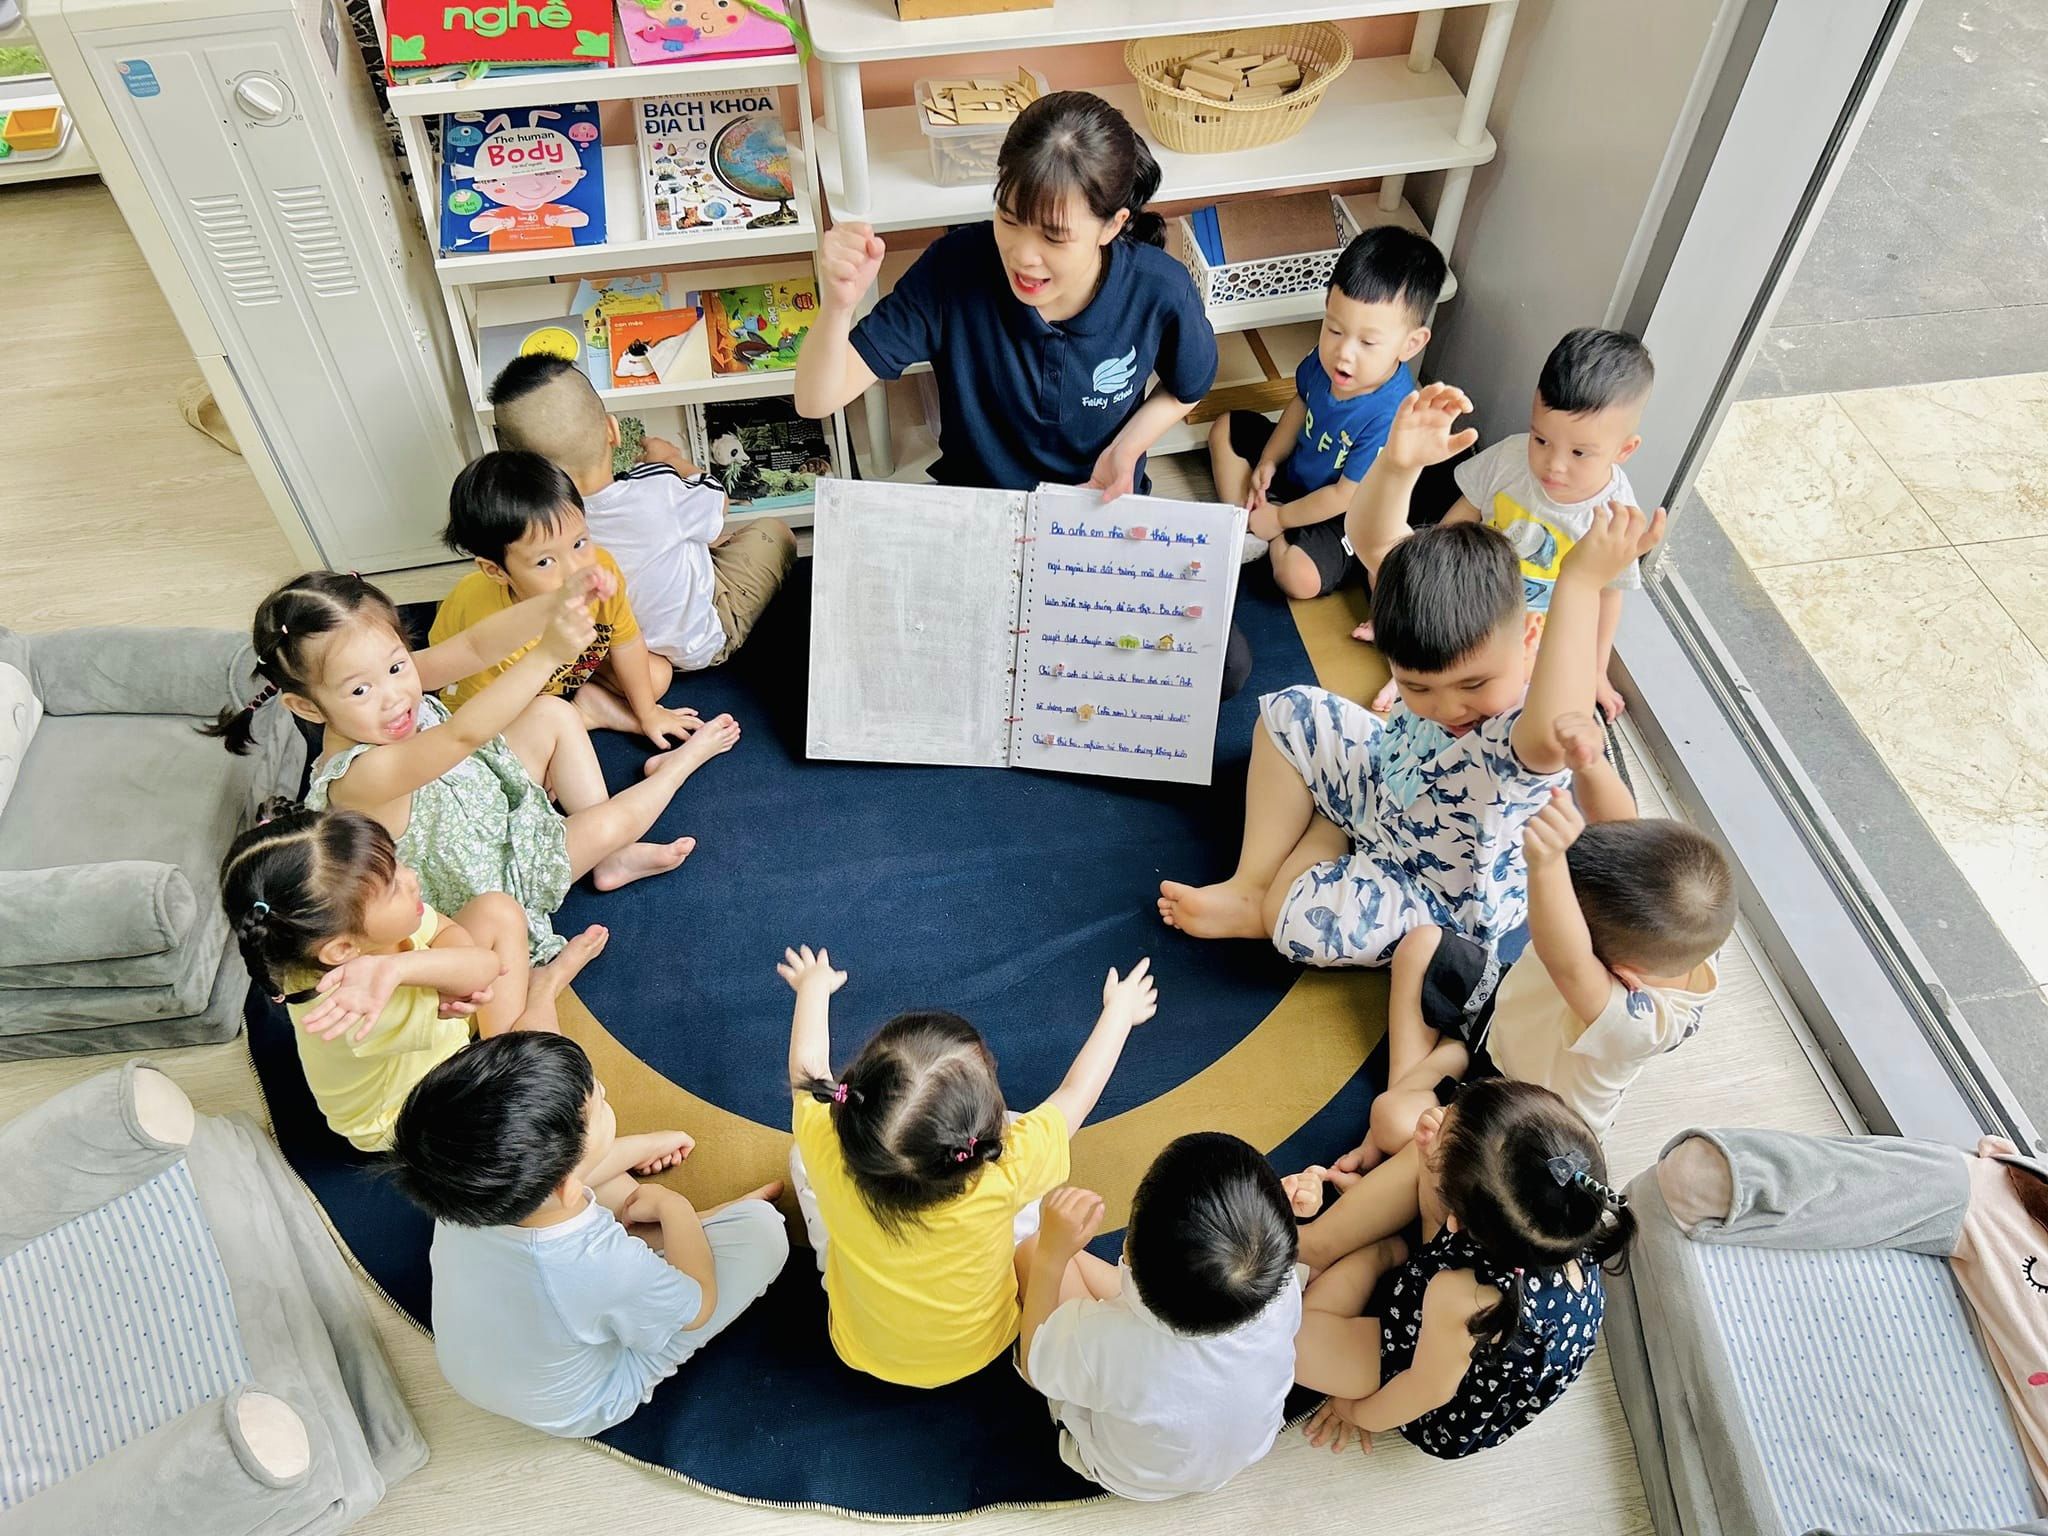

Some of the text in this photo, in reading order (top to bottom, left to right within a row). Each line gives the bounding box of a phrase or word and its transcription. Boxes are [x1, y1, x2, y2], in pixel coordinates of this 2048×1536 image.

[710, 97, 773, 114] KHOA
[644, 117, 682, 136] ĐỊA
[494, 132, 555, 145] The human
[487, 141, 564, 166] Body
[1051, 521, 1065, 535] Ba
[1068, 522, 1086, 536] anh
[1090, 529, 1104, 538] em
